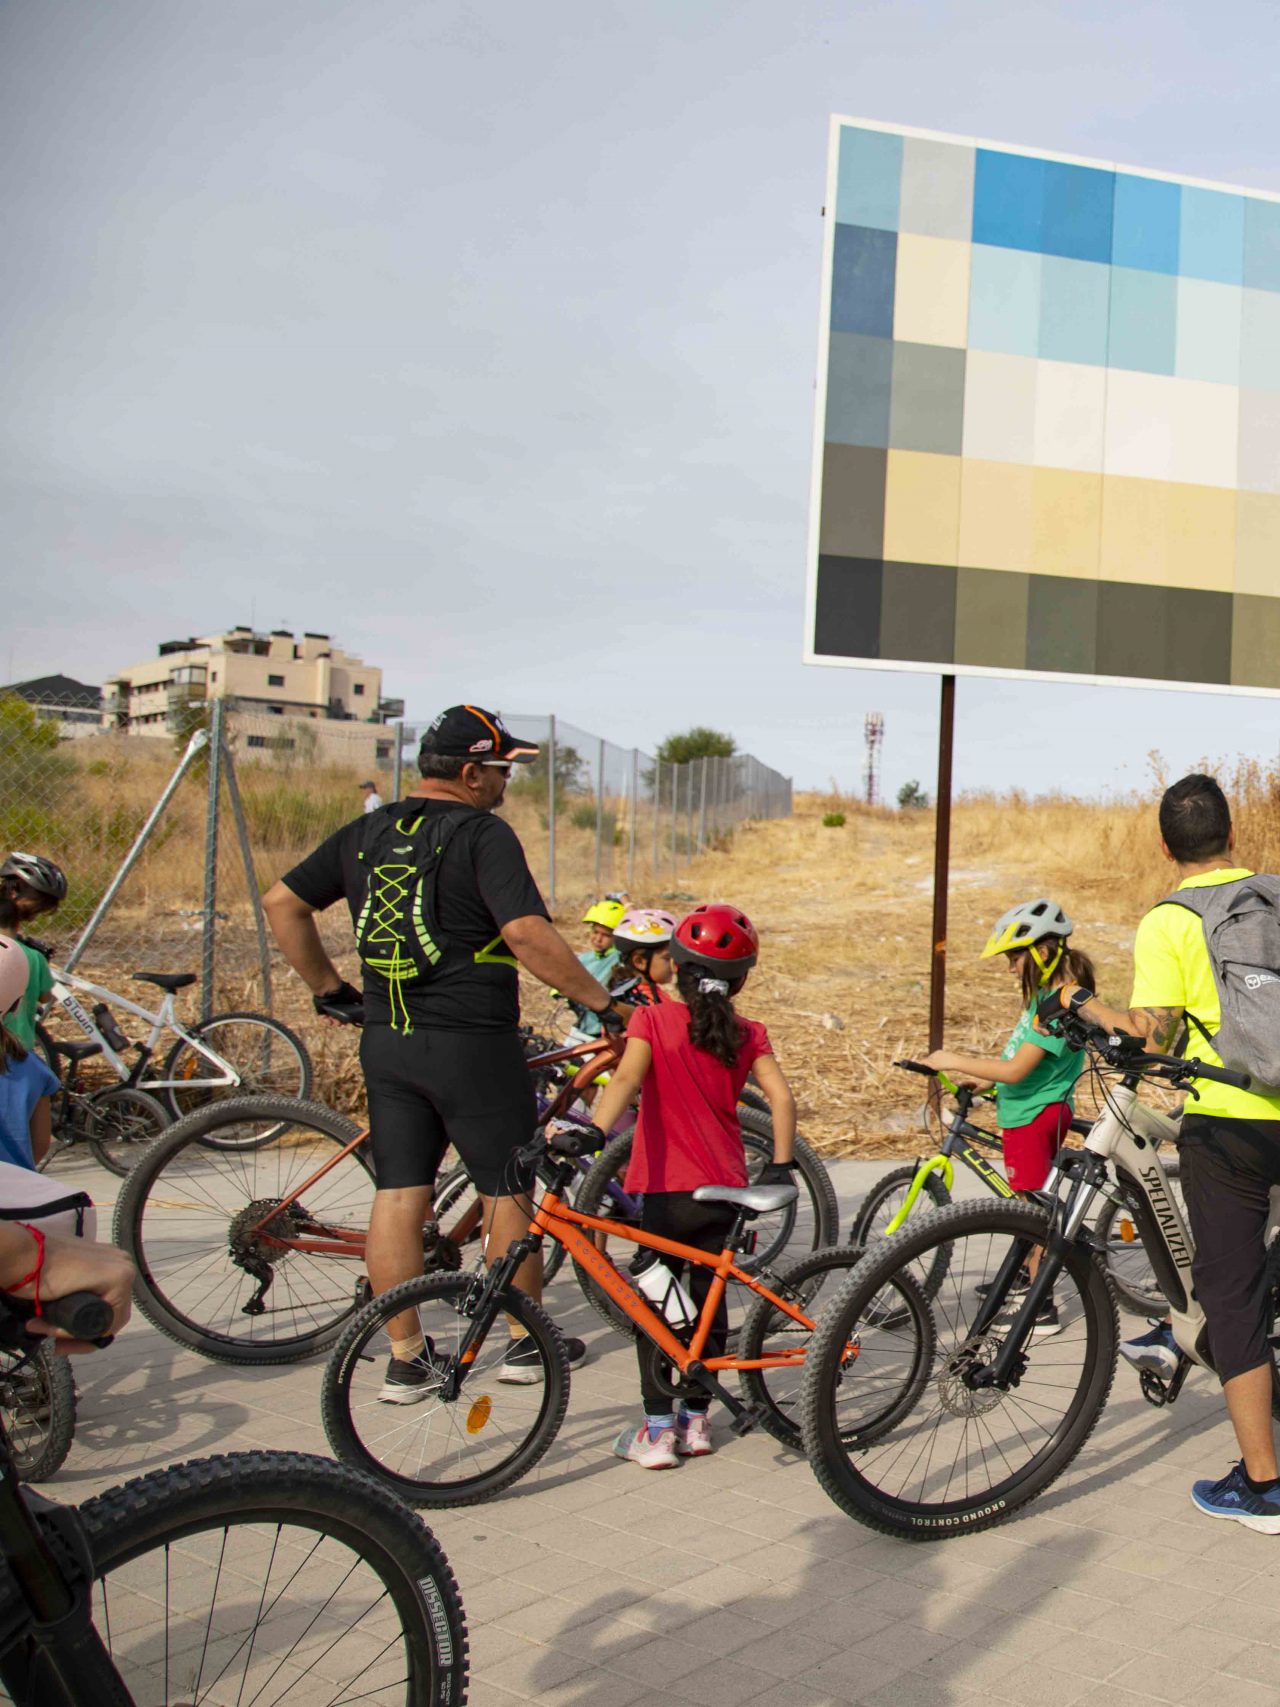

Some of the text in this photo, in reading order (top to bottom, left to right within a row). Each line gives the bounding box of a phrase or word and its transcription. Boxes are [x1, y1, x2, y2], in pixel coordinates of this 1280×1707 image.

[1138, 1166, 1192, 1269] SPECIALIZED
[911, 1517, 960, 1527] CONTROL
[962, 1499, 1007, 1523] GROUND
[416, 1574, 454, 1667] DISSECTOR
